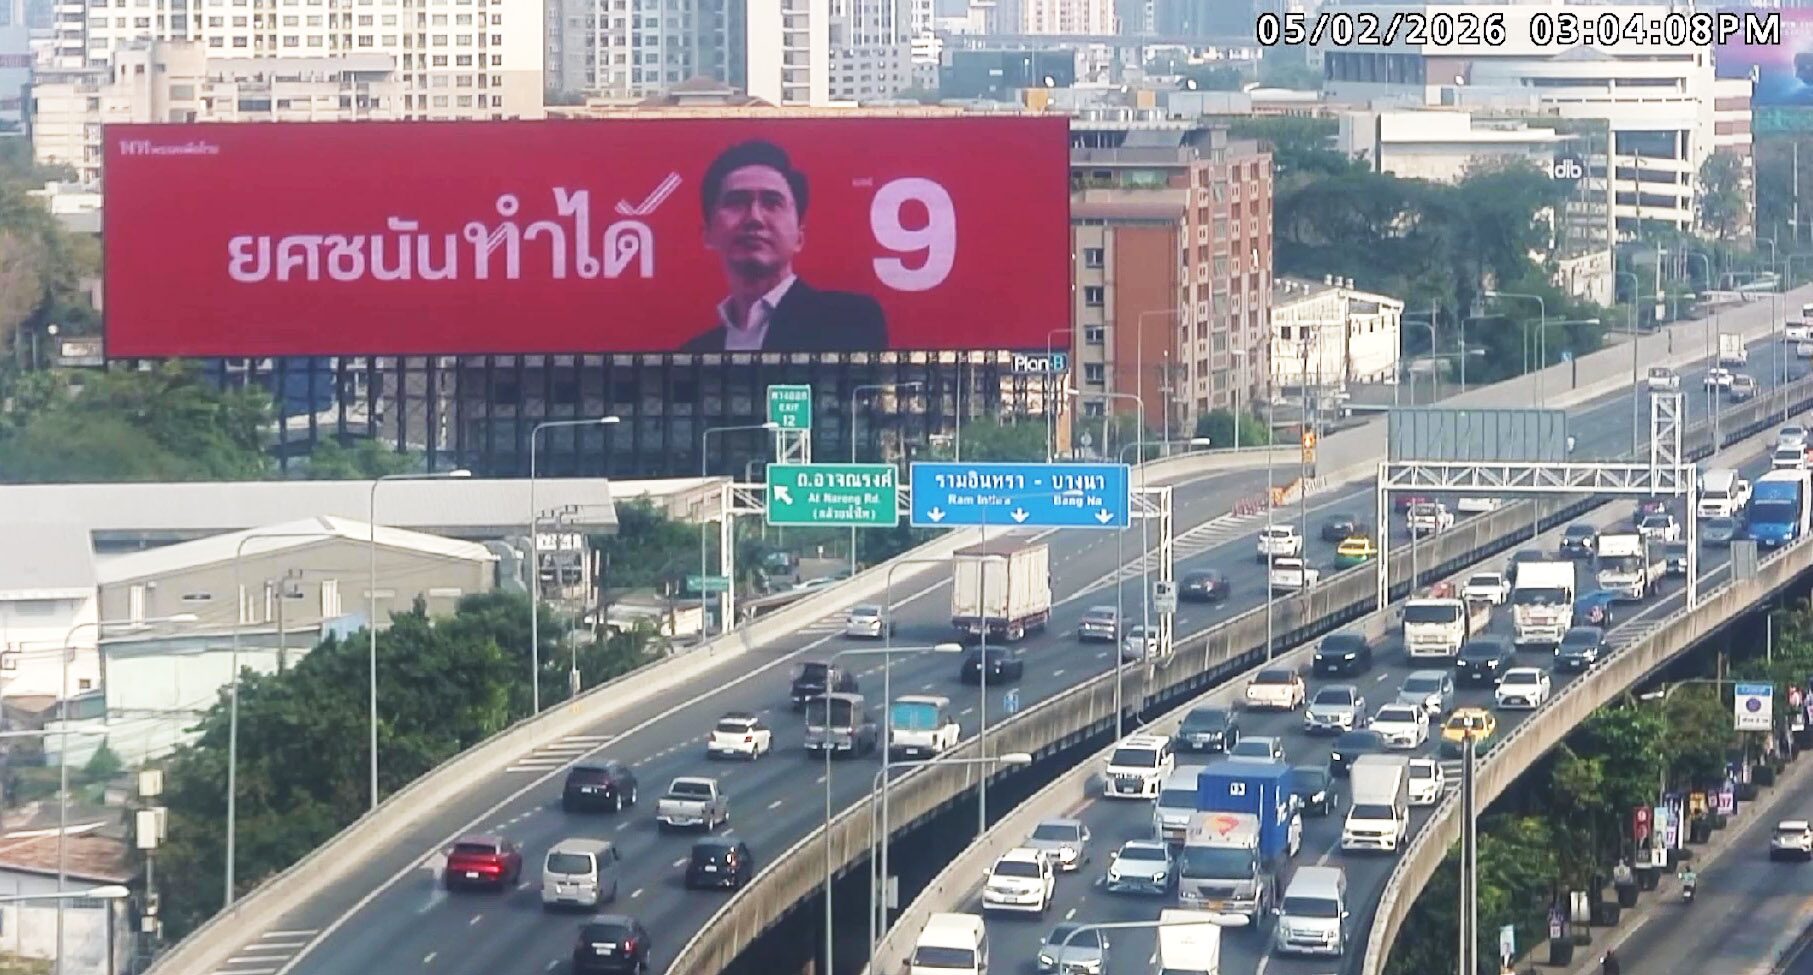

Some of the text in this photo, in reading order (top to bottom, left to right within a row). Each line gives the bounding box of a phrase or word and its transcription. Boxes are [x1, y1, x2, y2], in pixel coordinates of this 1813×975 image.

[1555, 159, 1582, 178] dib
[870, 177, 957, 291] 9
[1014, 355, 1049, 371] Plan
[783, 415, 796, 427] 12
[935, 470, 1025, 489] รามอินทรา
[1052, 474, 1105, 490] บางนา
[947, 494, 974, 505] Ram
[1053, 494, 1084, 507] Bang
